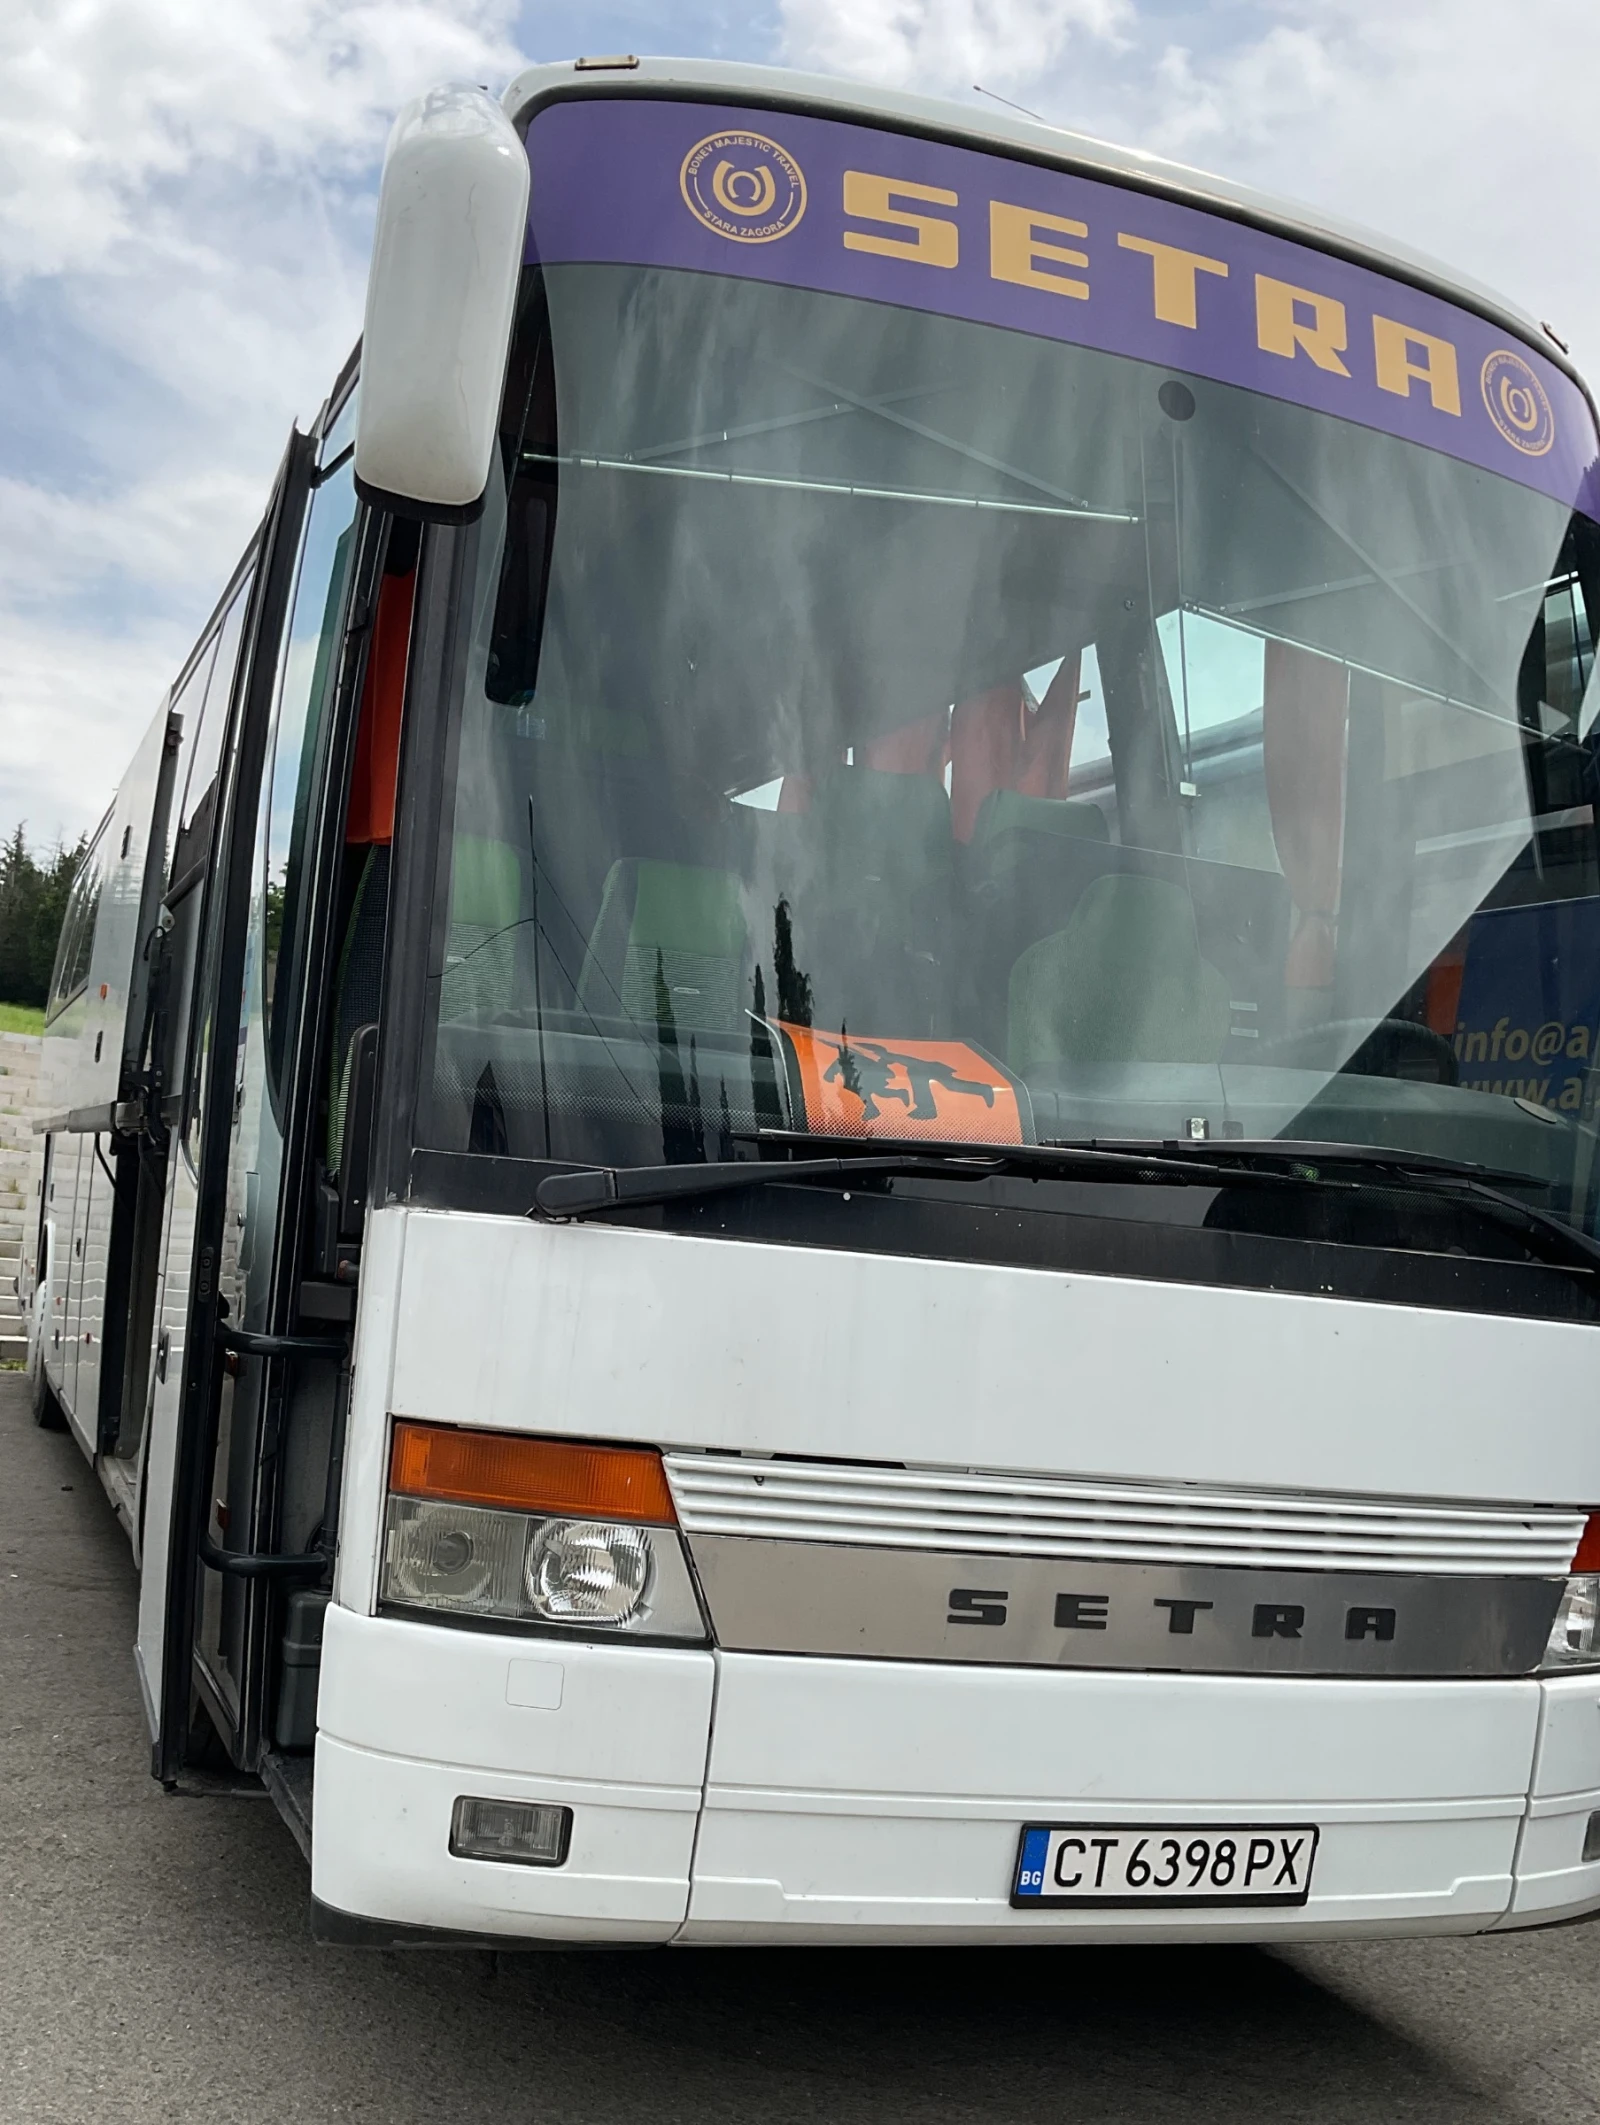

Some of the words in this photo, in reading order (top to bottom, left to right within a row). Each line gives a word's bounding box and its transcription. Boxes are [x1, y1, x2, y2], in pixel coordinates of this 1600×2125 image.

[688, 144, 713, 175] BONEV
[714, 137, 771, 153] MAJESTIC
[772, 150, 799, 188] TRAVEL
[704, 210, 738, 234] STARA
[740, 220, 785, 237] ZAGORA
[843, 170, 1461, 417] SETRA
[947, 1588, 1396, 1641] SETRA
[1020, 1870, 1041, 1885] BG
[1053, 1838, 1119, 1888] CT
[1125, 1838, 1237, 1887] 6398
[1243, 1838, 1305, 1887] PX
